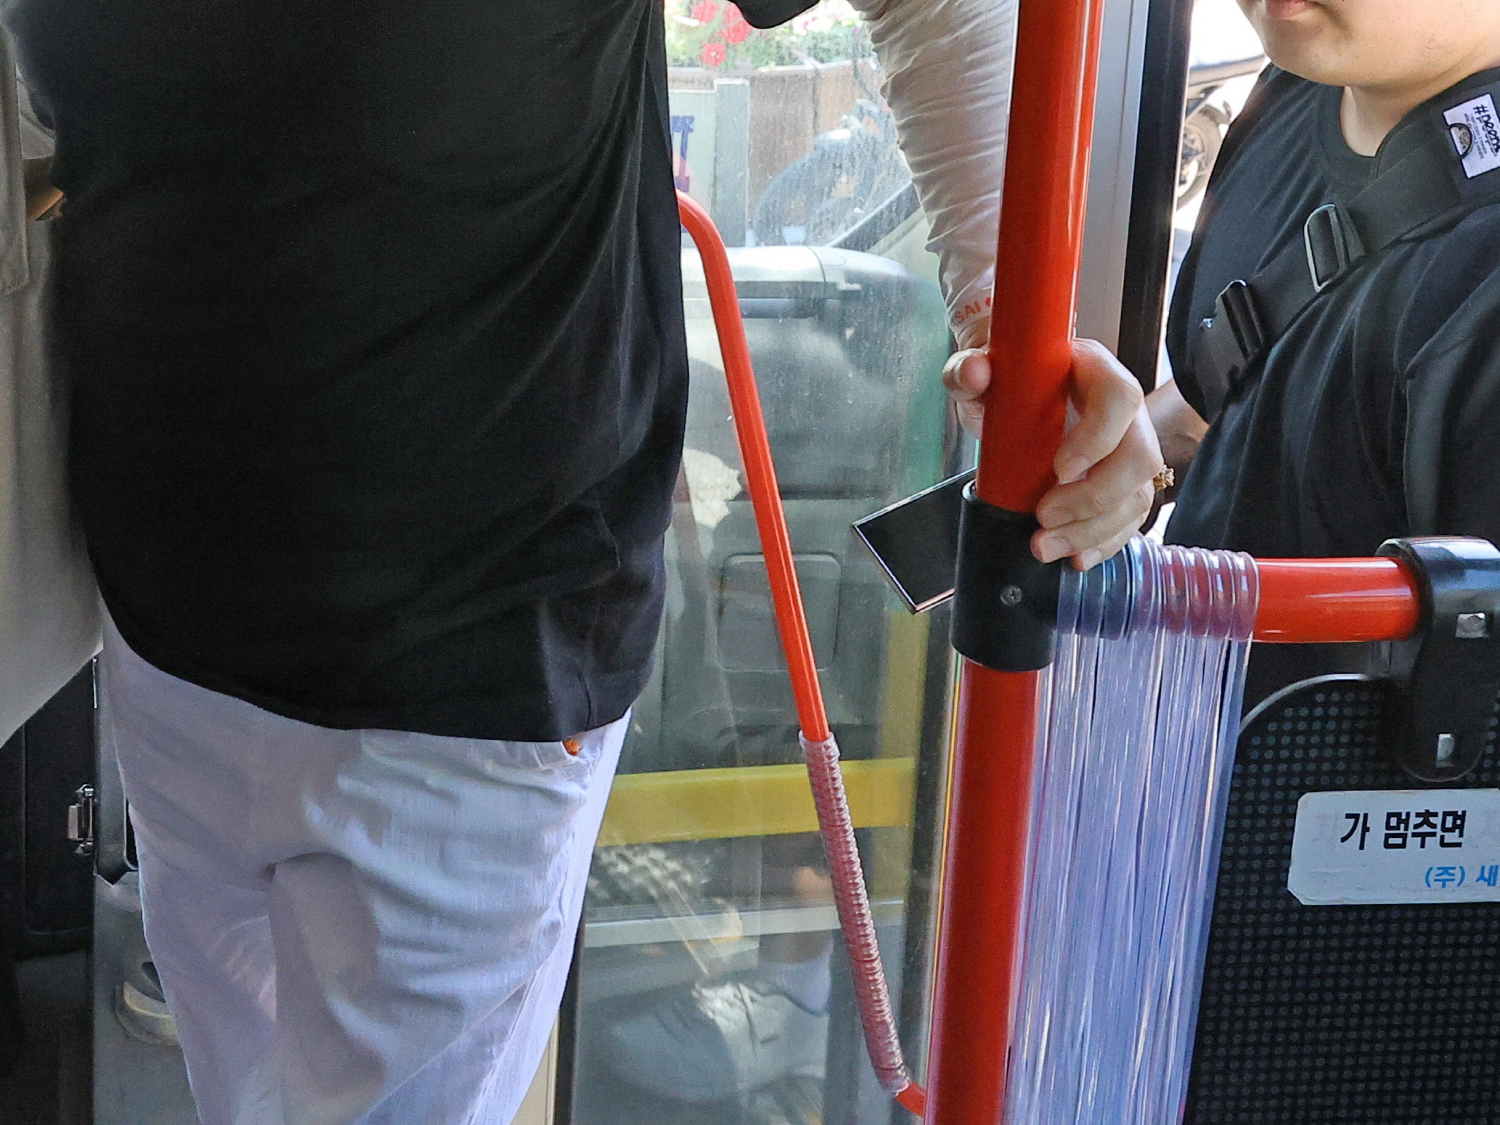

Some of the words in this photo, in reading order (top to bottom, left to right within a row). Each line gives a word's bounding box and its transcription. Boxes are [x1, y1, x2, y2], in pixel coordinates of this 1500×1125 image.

[1340, 812, 1370, 851] 가
[1383, 809, 1467, 850] 멈추면
[1425, 865, 1466, 889] (주)
